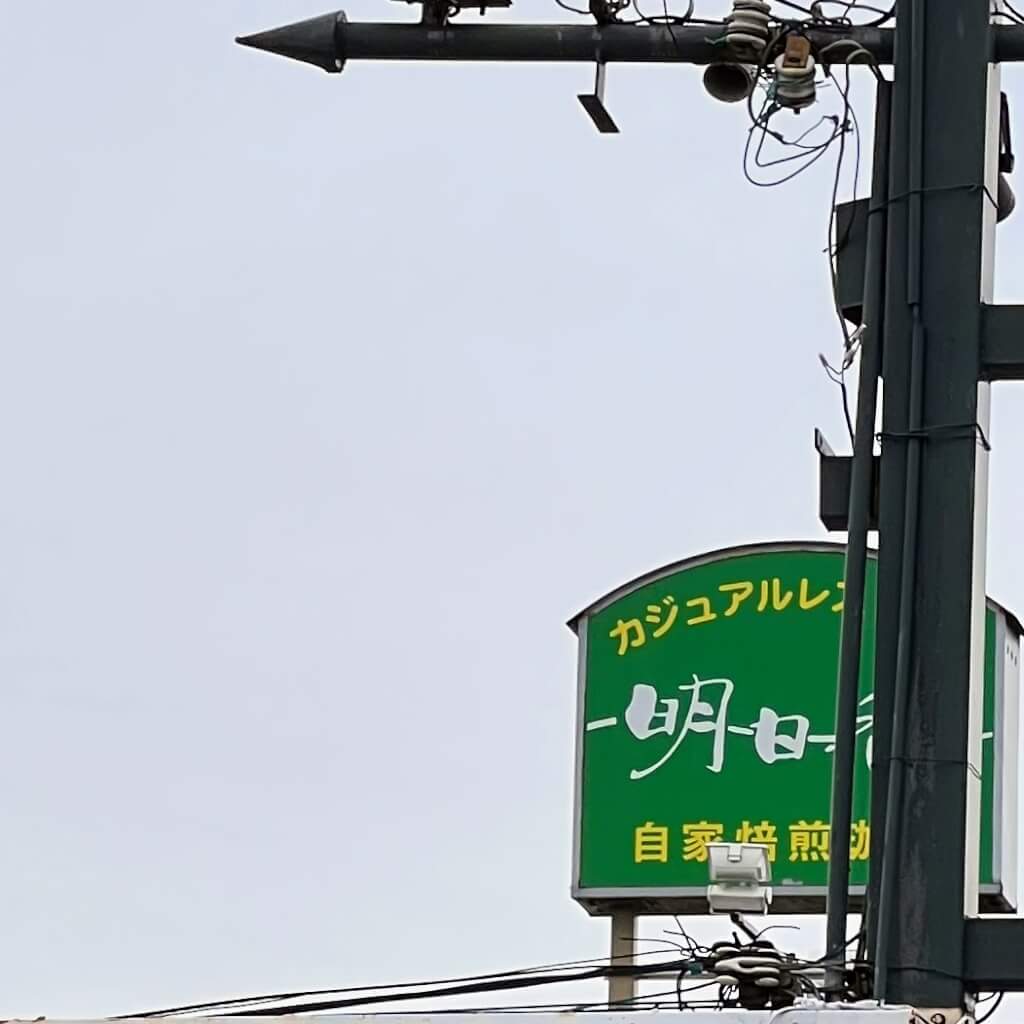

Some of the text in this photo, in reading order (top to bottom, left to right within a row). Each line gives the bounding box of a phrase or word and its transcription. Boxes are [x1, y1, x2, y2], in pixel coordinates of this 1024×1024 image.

[608, 577, 847, 656] カジュアルレ
[624, 673, 875, 780] 明日
